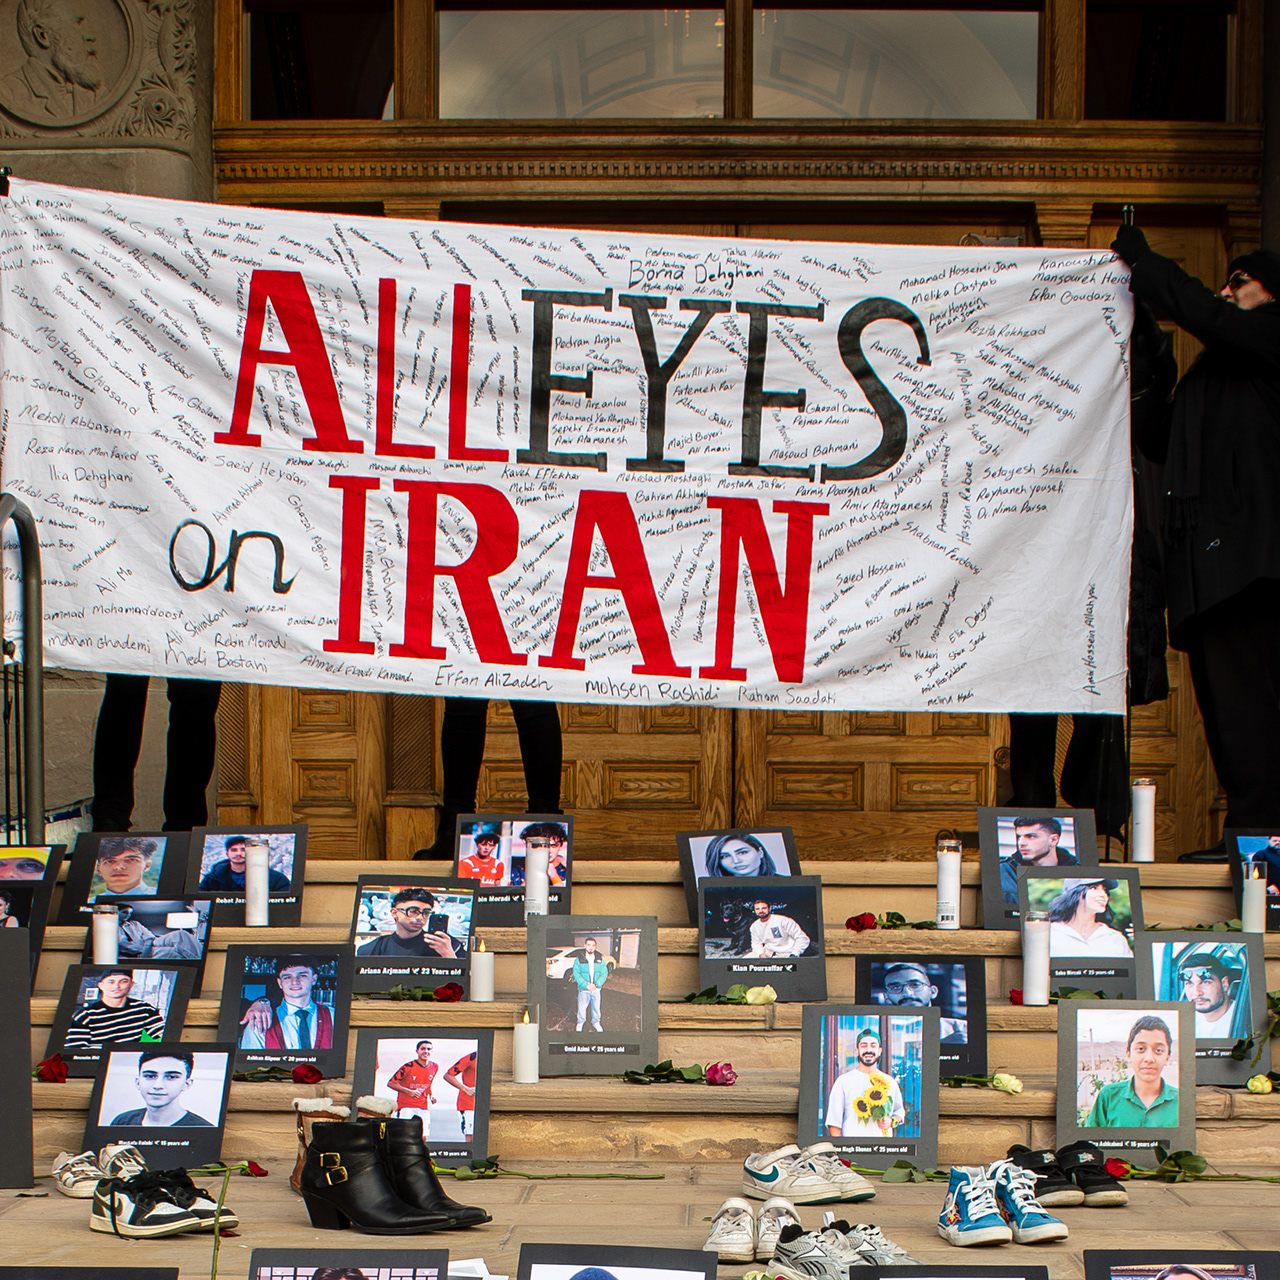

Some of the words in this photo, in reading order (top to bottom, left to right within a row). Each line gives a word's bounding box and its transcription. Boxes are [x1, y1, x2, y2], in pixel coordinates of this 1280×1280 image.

[629, 259, 684, 288] Borna
[694, 262, 764, 289] Dehghani
[214, 270, 509, 463] ALL
[517, 288, 931, 485] EYES
[18, 405, 66, 425] Mehdi
[70, 416, 131, 439] Abbasian
[813, 440, 859, 458] Bahmani
[75, 467, 133, 489] Dehghani
[170, 518, 300, 593] on
[323, 475, 830, 683] IRAN
[435, 664, 478, 687] Erfan
[657, 682, 721, 702] Rashidi
[785, 687, 836, 704] Saadati
